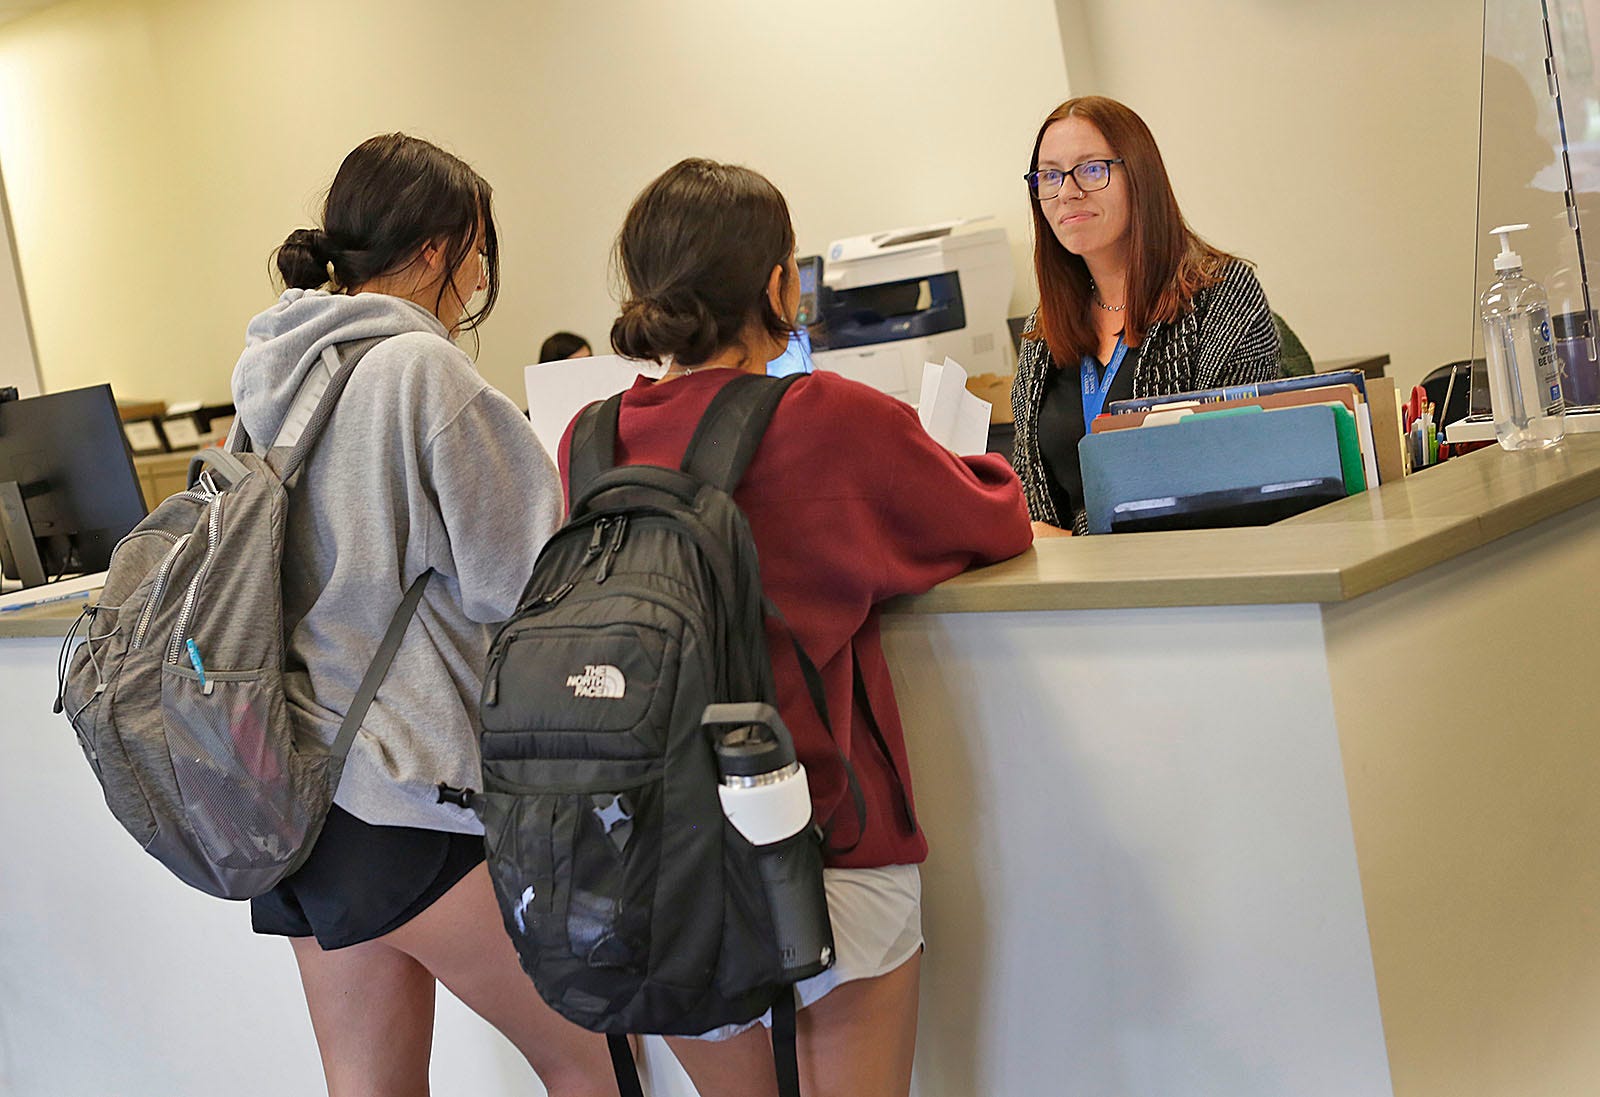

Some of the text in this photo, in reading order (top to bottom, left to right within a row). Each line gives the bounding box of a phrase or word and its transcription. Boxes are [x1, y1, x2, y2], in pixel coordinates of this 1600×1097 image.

[584, 665, 606, 677] THE
[566, 674, 605, 688] NORTH
[574, 685, 605, 697] FACE
